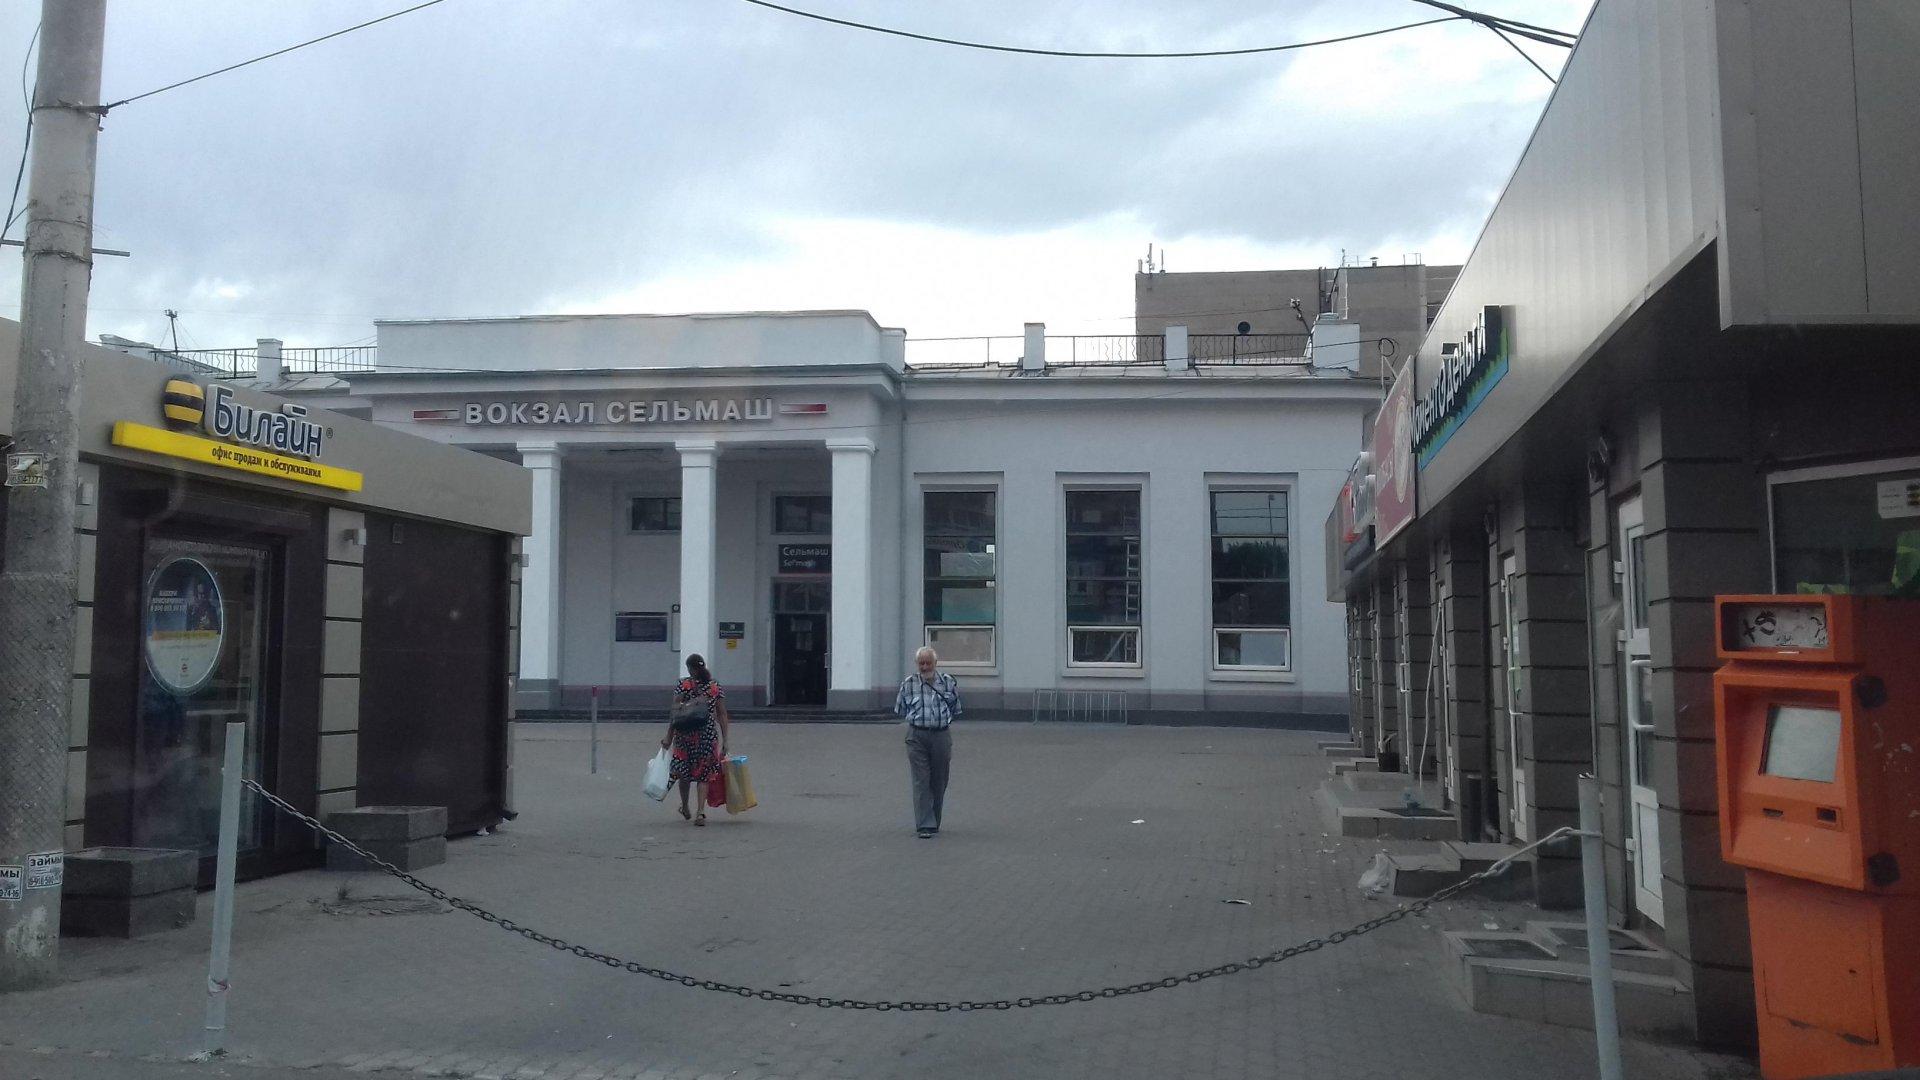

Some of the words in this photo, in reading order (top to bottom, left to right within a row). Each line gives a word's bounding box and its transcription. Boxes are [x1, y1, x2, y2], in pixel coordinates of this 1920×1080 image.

[211, 385, 322, 458] Билайн
[465, 401, 595, 424] ВОКЗАЛ
[606, 398, 773, 423] СЕЛЬМАШ
[212, 446, 232, 460] офис
[233, 452, 263, 466] продаж
[264, 459, 270, 468] и
[270, 458, 322, 478] обслуживания
[783, 546, 829, 556] Сельмаш
